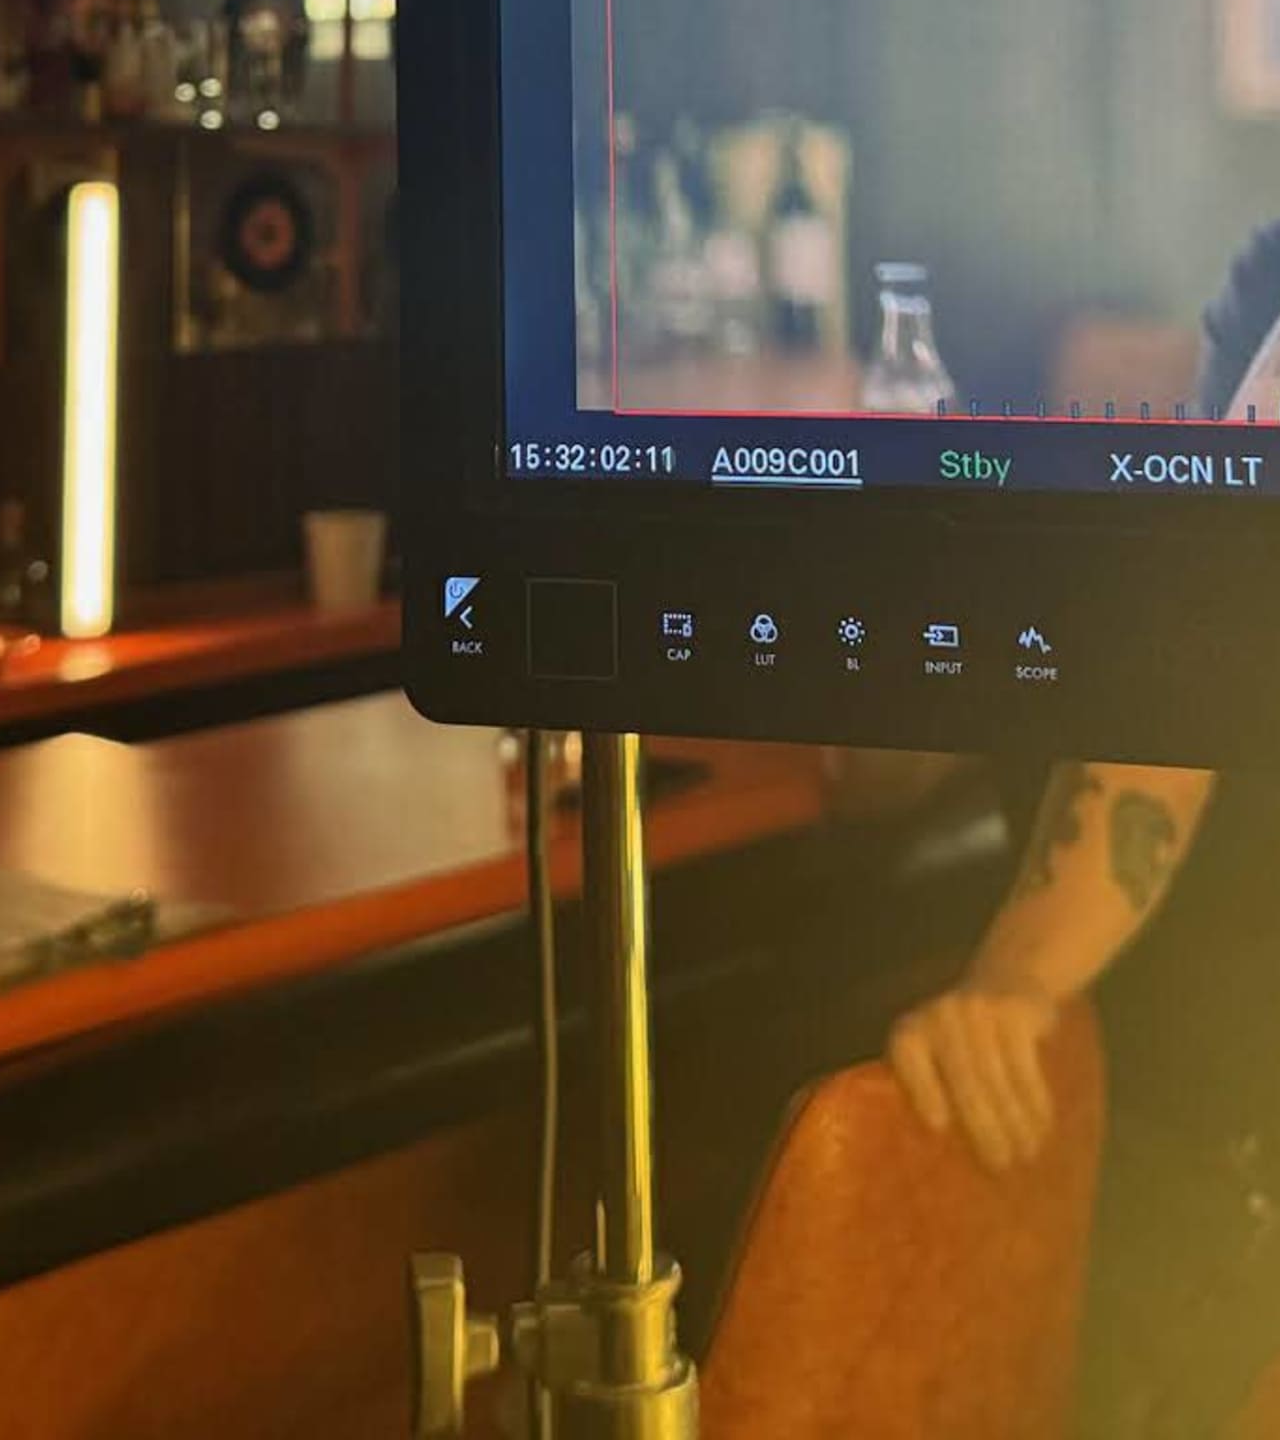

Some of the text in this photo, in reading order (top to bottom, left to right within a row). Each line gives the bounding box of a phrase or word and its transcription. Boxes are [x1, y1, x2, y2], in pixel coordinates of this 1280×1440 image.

[510, 442, 674, 474] 15:32:02:11
[711, 446, 861, 477] A009C001
[938, 448, 1012, 486] Stby
[1109, 452, 1214, 485] X-OCN
[1224, 456, 1264, 486] LT
[451, 640, 483, 655] BACK
[666, 647, 692, 662] CAP
[754, 652, 777, 667] LUT
[924, 661, 963, 676] INPUT
[1015, 666, 1059, 681] SCOPE
